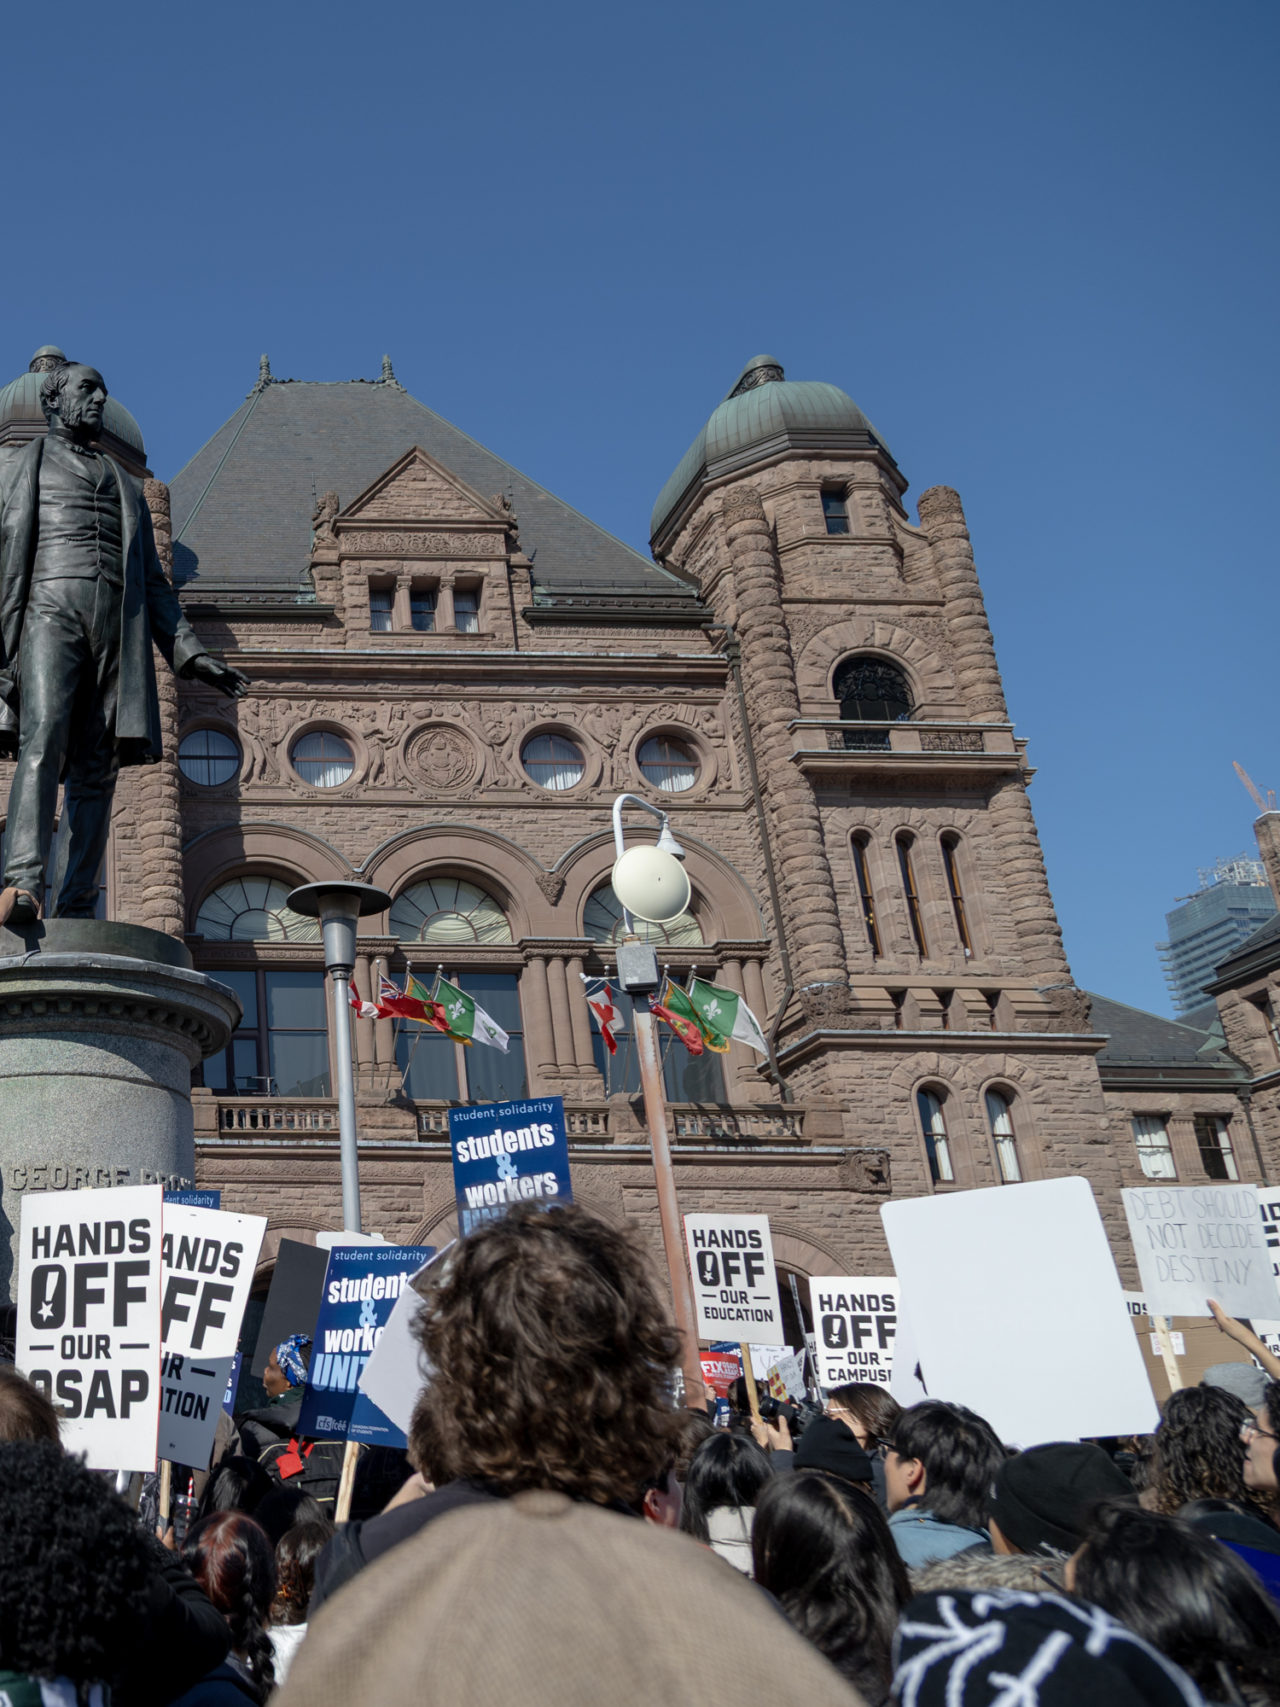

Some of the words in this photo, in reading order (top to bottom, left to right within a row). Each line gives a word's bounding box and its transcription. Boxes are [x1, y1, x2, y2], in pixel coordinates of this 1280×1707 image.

[454, 1109, 495, 1121] student
[499, 1102, 553, 1116] solidarity
[456, 1123, 555, 1163] students
[10, 1164, 130, 1191] GEORGE
[496, 1152, 518, 1180] &
[182, 1195, 214, 1207] solidarity
[465, 1172, 558, 1208] workers
[1129, 1190, 1187, 1220] DEBT
[1192, 1189, 1258, 1218] SHOULD
[32, 1218, 151, 1260] HANDS
[692, 1229, 762, 1248] HANDS
[1146, 1223, 1188, 1249] NOT
[1197, 1223, 1262, 1248] DECIDE
[334, 1250, 374, 1261] student
[376, 1250, 427, 1263] solidarity
[697, 1251, 764, 1287] OFF
[1156, 1255, 1253, 1286] DESTINY
[30, 1260, 150, 1330] OFF
[720, 1290, 749, 1304] OUR
[819, 1294, 896, 1312] HANDS
[358, 1299, 378, 1327] &
[704, 1307, 773, 1322] EDUCATION
[822, 1315, 897, 1349] OFF
[60, 1334, 112, 1360] OUR
[847, 1352, 880, 1365] OUR
